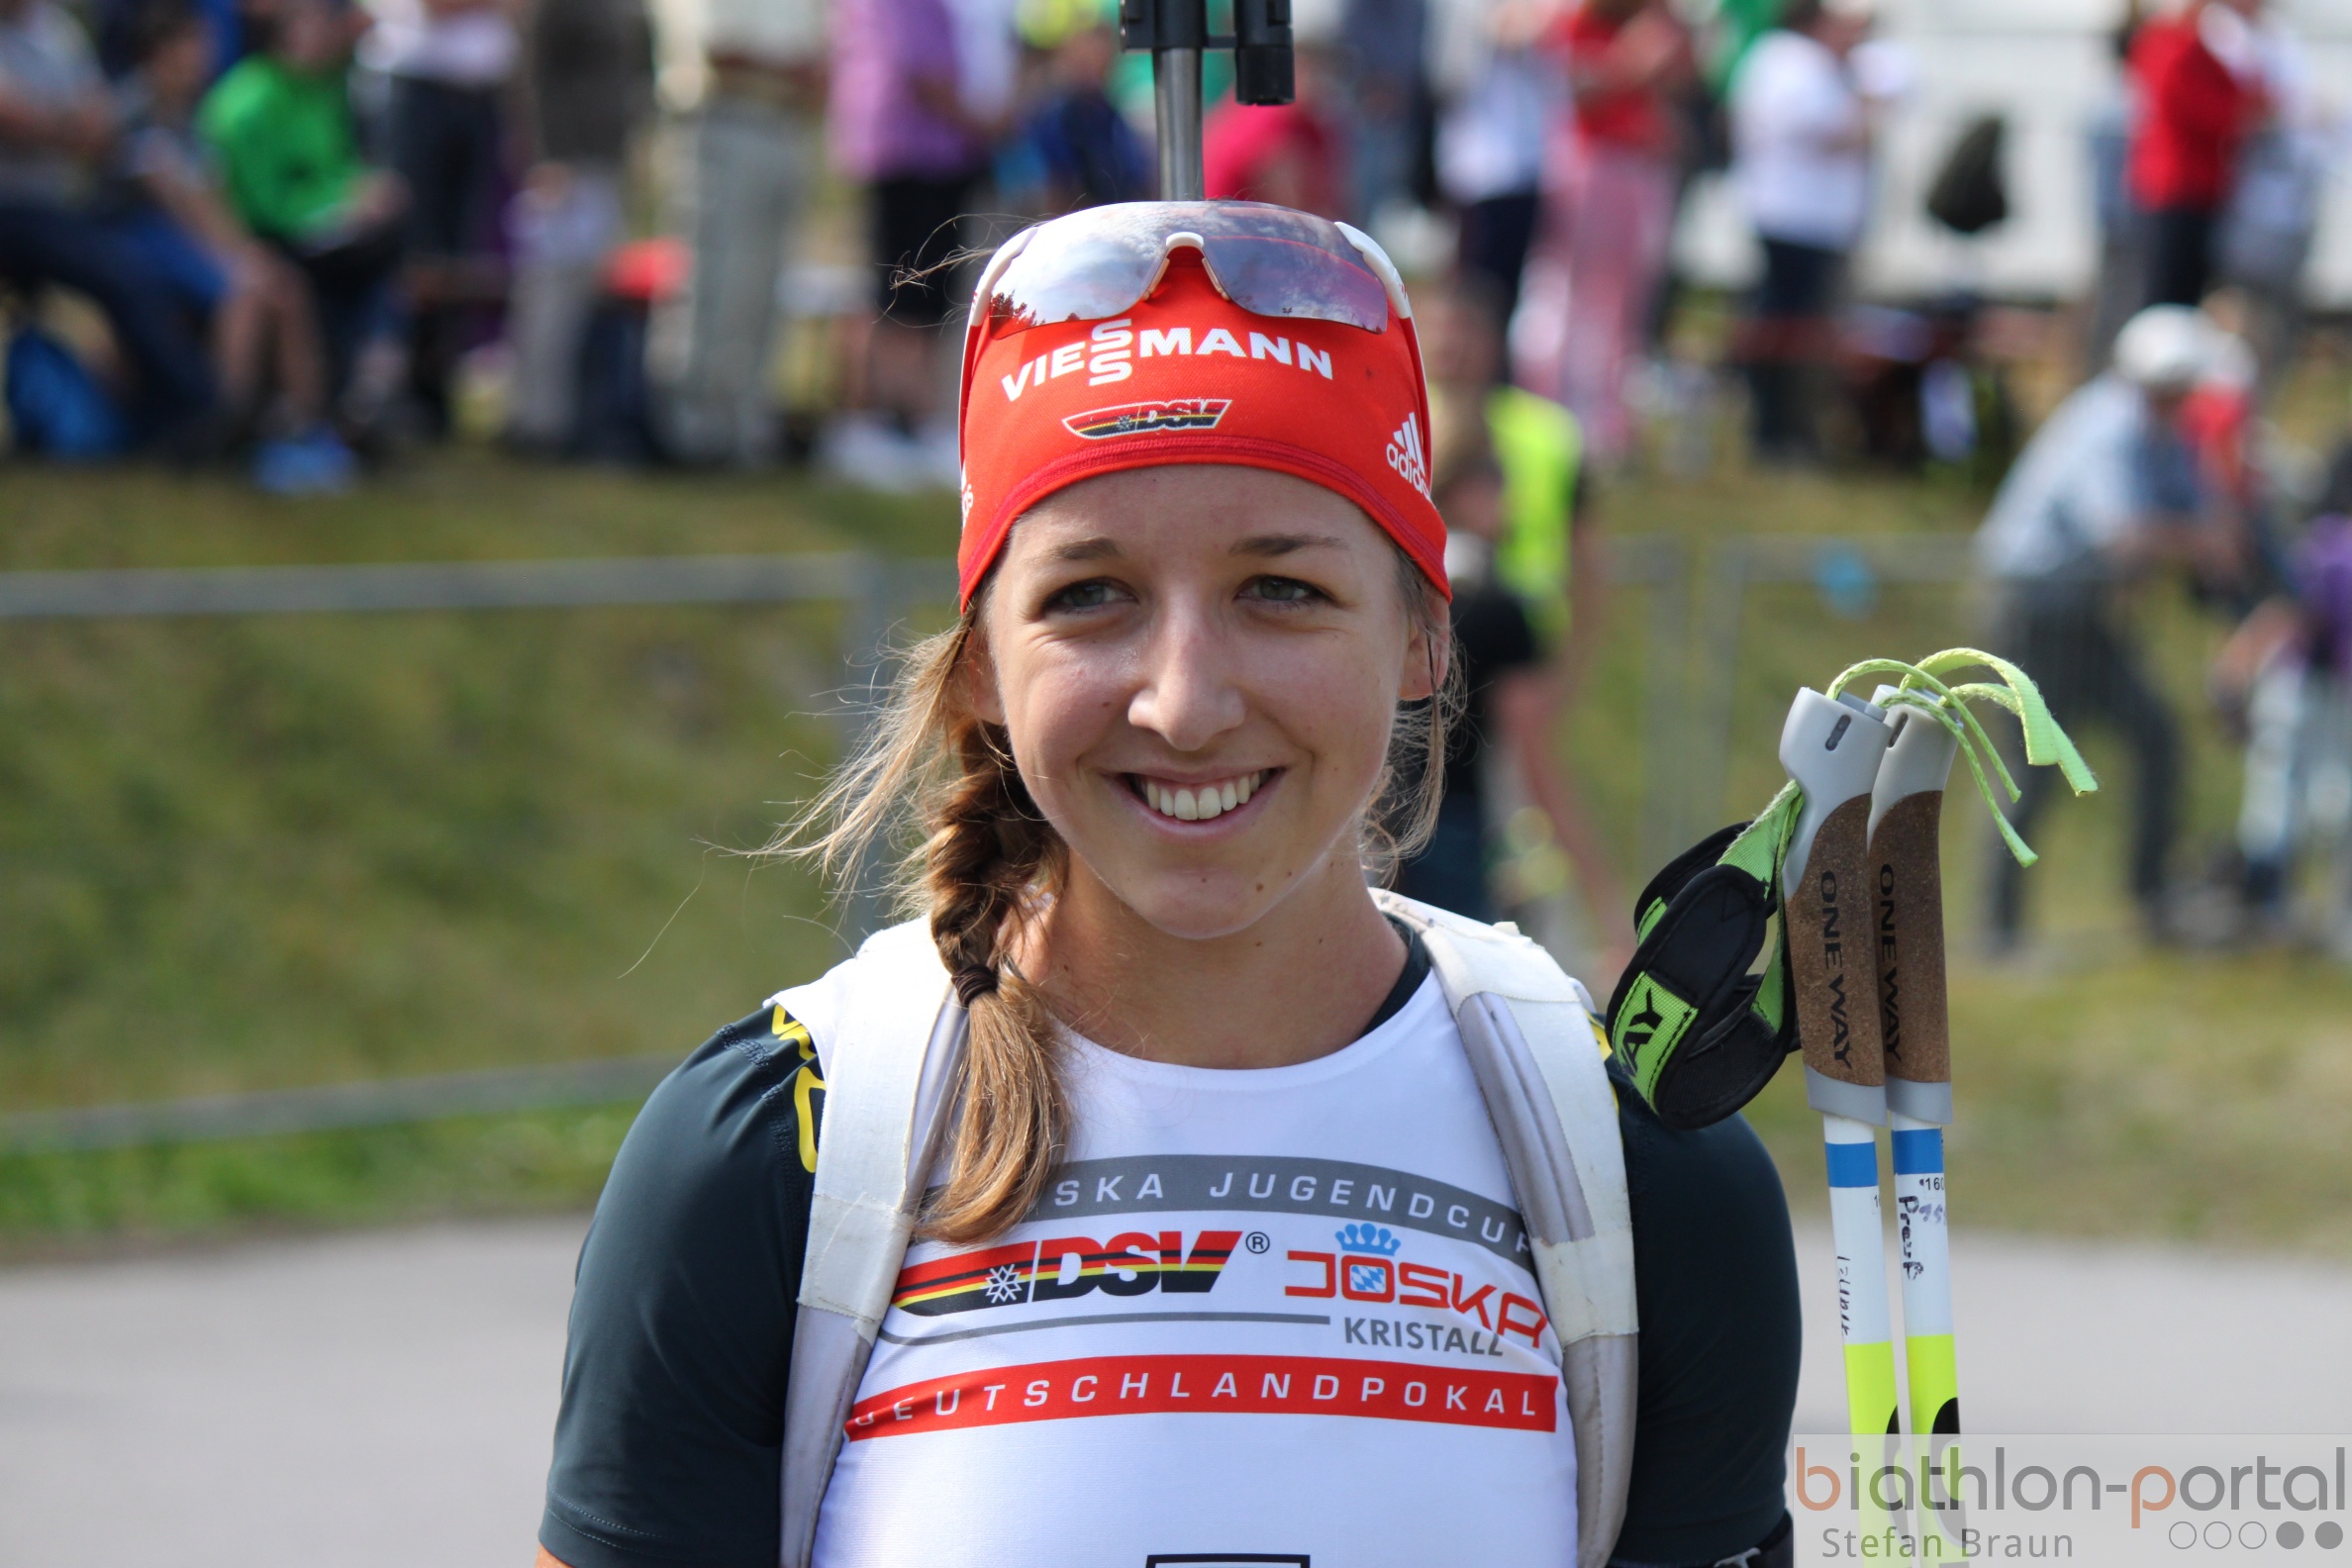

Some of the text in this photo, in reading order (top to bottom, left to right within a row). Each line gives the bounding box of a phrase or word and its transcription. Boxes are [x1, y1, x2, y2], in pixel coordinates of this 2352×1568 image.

[1001, 318, 1333, 402] VIESSMANN
[1386, 442, 1435, 508] adida
[1819, 870, 1853, 1070] ONE WAY
[1879, 863, 1903, 1063] ONE WAY
[1620, 987, 1663, 1078] AY
[1054, 1172, 1164, 1207] SKA
[1285, 1249, 1548, 1349] JOSKA
[1344, 1316, 1504, 1357] KRISTALL
